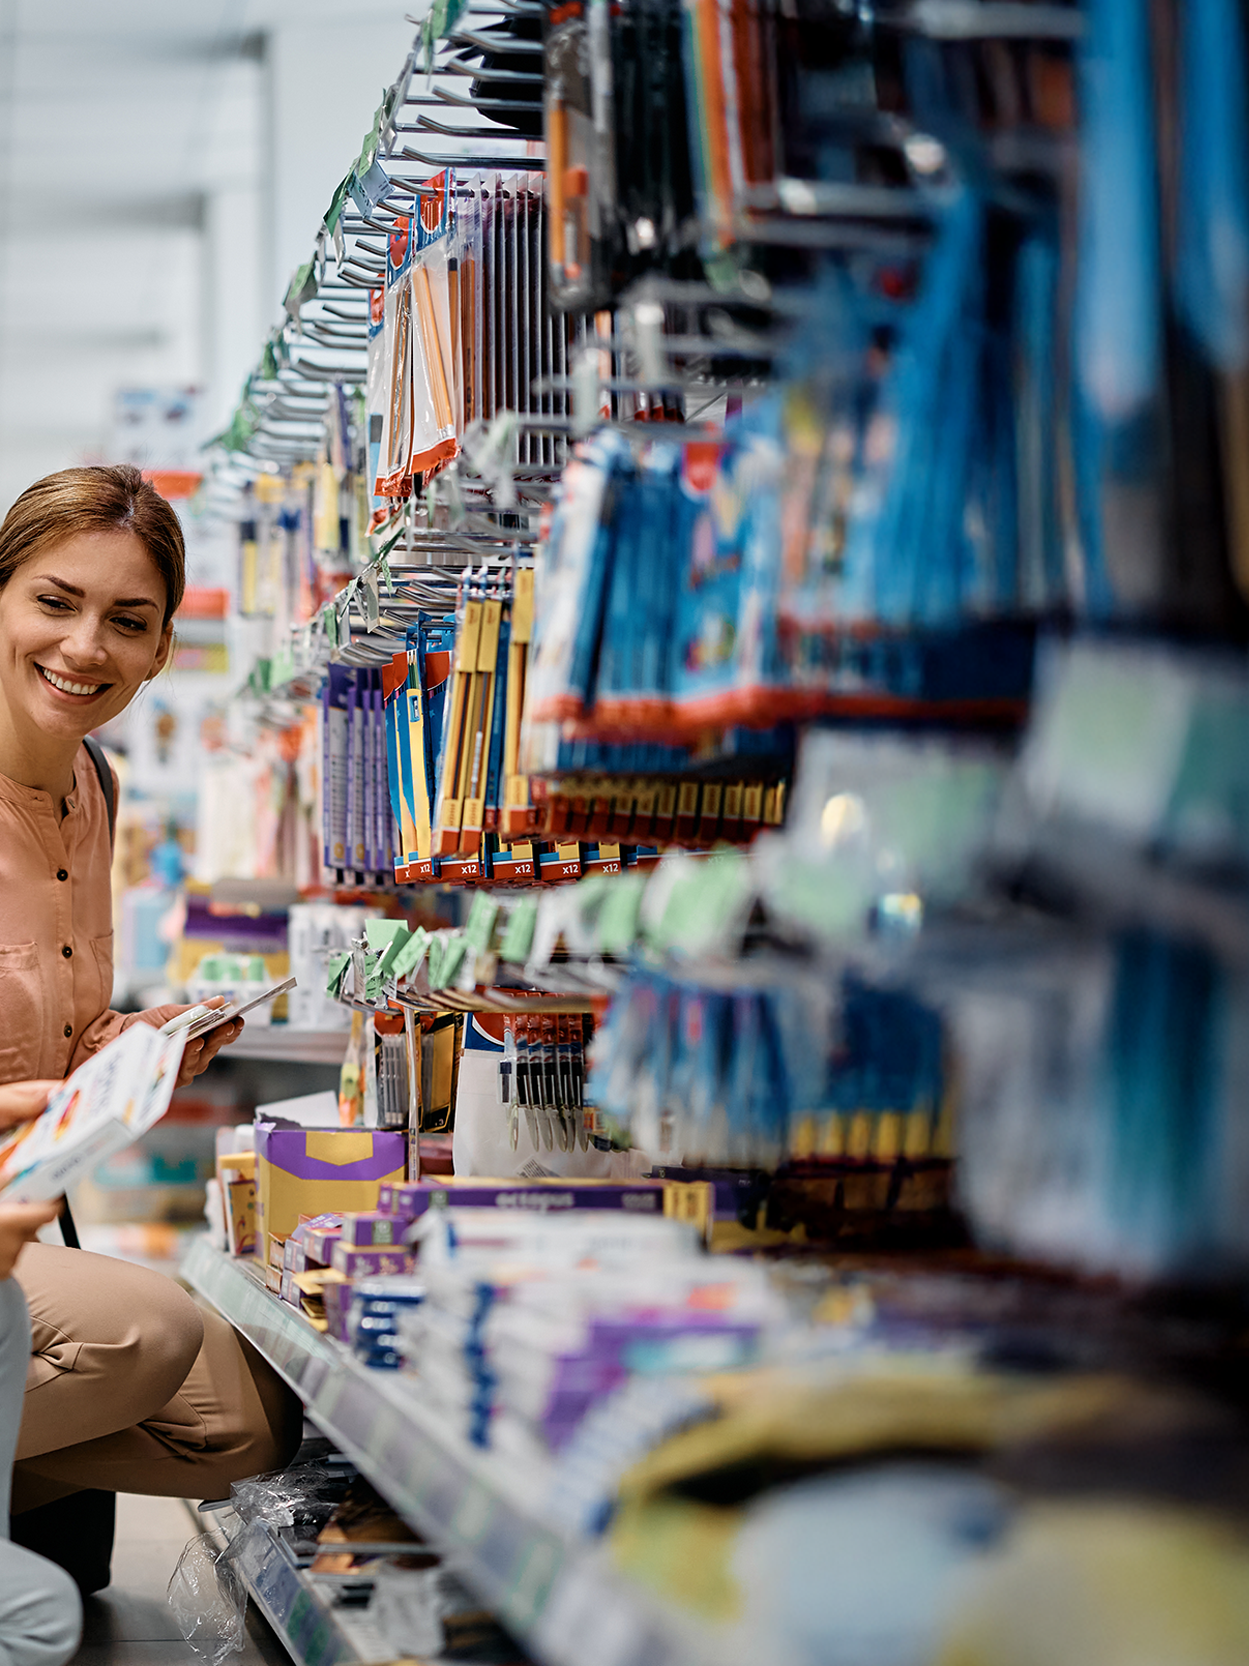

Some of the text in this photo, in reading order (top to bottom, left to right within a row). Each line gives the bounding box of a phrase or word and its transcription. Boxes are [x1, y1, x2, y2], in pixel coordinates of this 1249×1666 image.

[420, 864, 430, 874] x12
[461, 864, 477, 874] x12
[514, 864, 531, 874] x12
[562, 864, 579, 874] x12
[602, 863, 619, 874] x12
